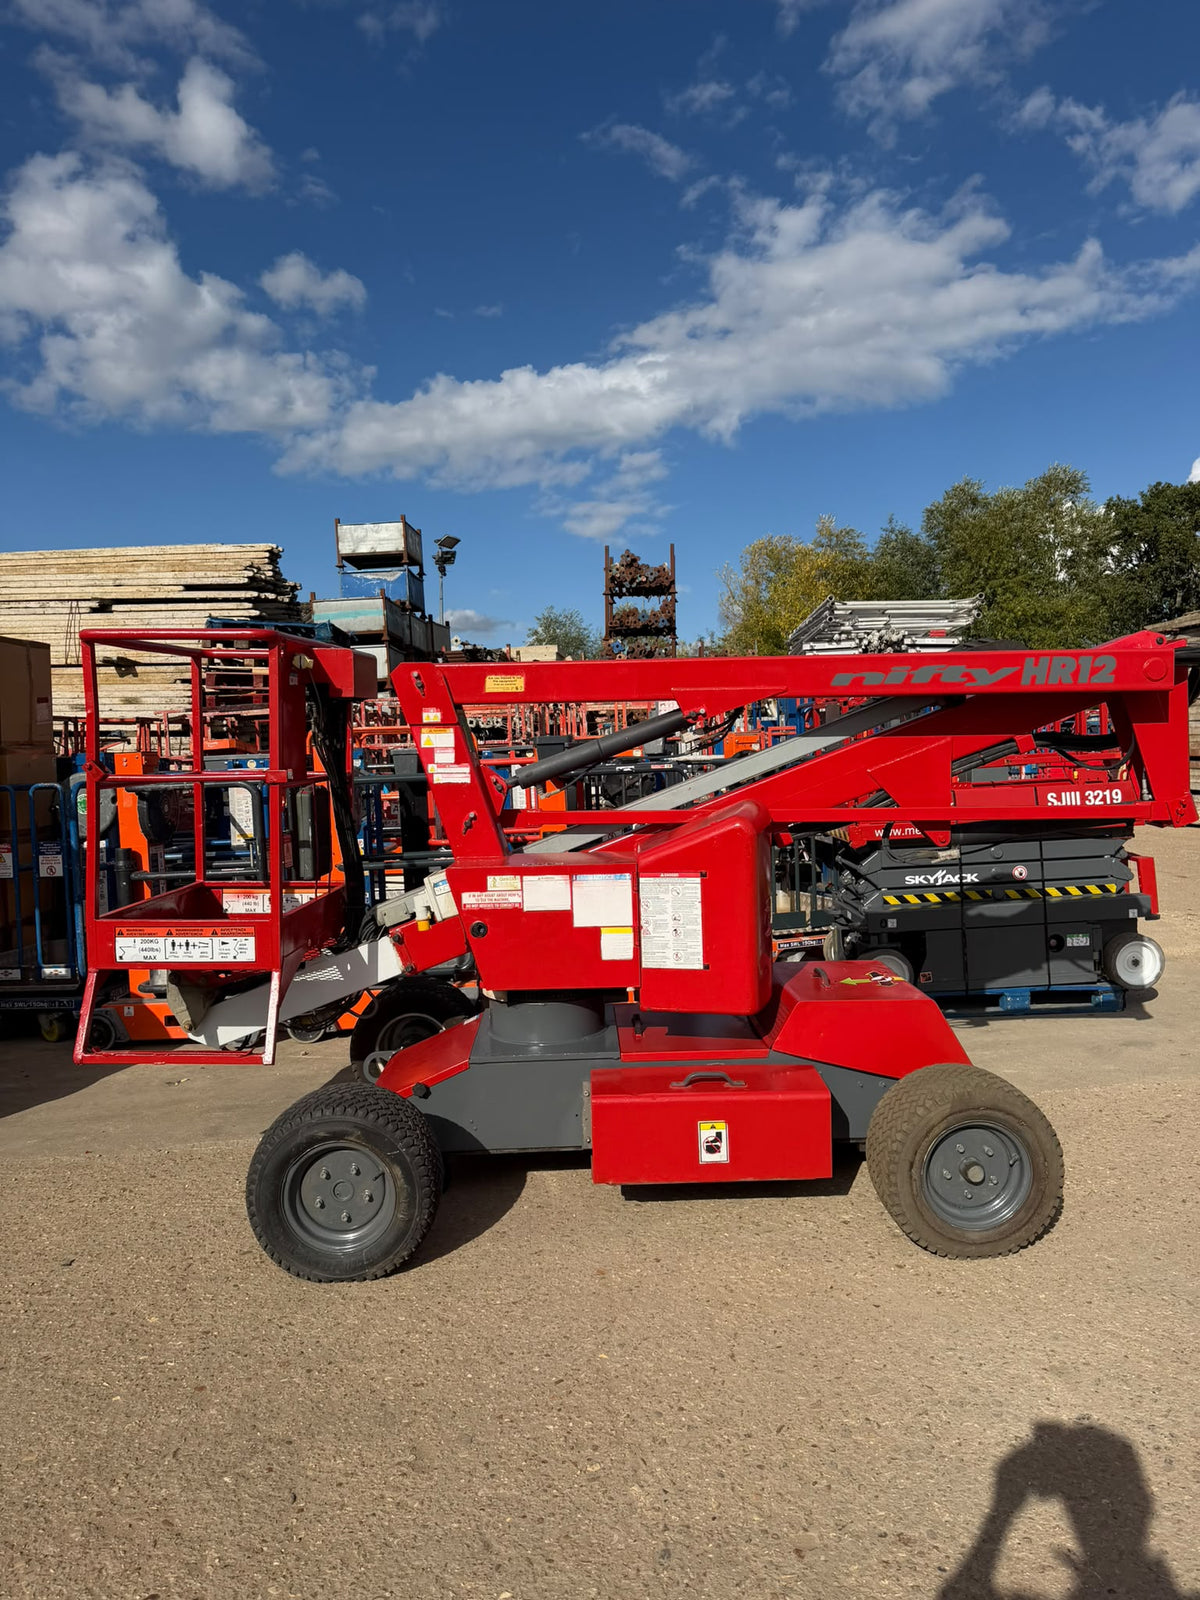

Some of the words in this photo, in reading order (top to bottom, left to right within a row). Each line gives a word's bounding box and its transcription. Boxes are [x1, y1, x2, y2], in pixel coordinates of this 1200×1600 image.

[830, 664, 1021, 687] nifty
[1021, 655, 1117, 686] HR12
[1047, 791, 1080, 806] SJIII
[1085, 788, 1122, 806] 3219
[905, 869, 979, 886] SKYJACK
